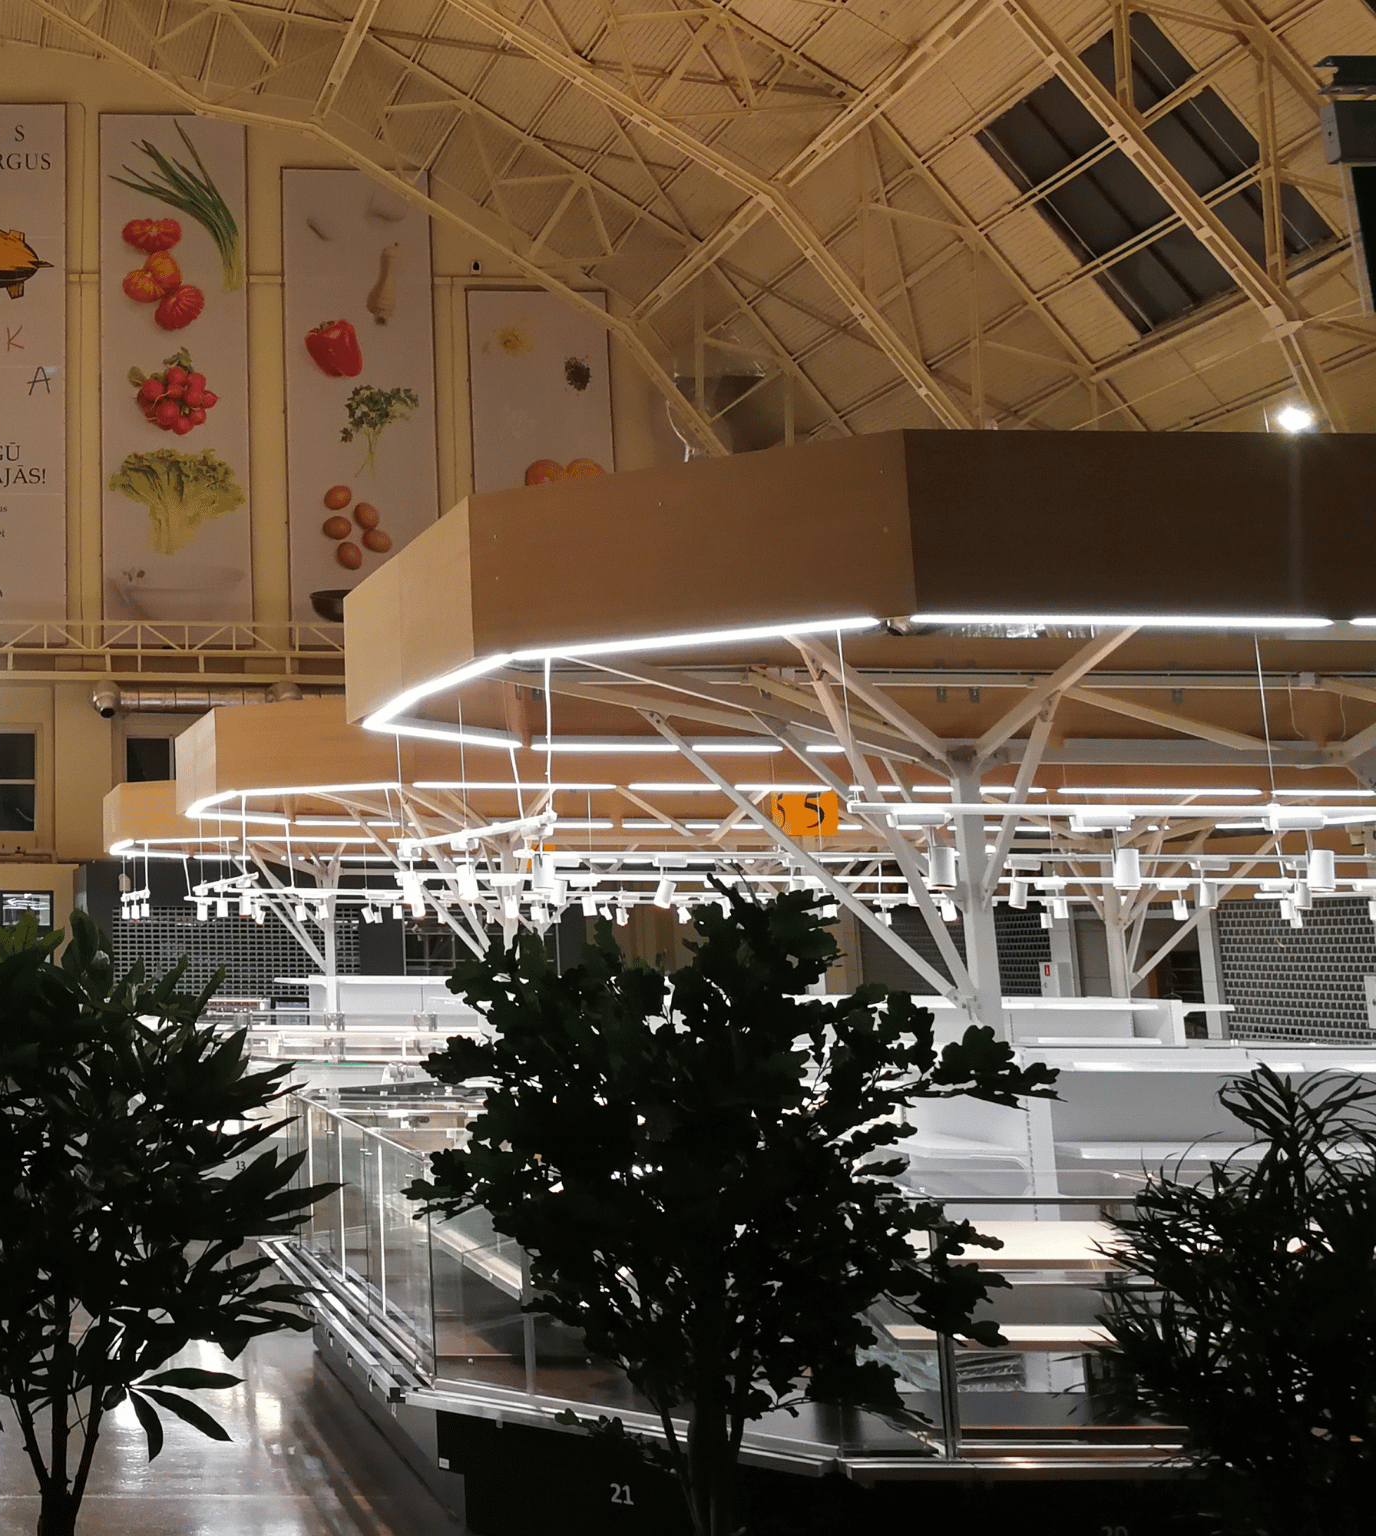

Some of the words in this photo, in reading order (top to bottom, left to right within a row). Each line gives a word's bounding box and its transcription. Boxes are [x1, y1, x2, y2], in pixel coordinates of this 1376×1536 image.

[6, 325, 25, 352] K
[26, 366, 51, 396] A
[236, 1160, 246, 1171] 13
[610, 1482, 634, 1506] 21
